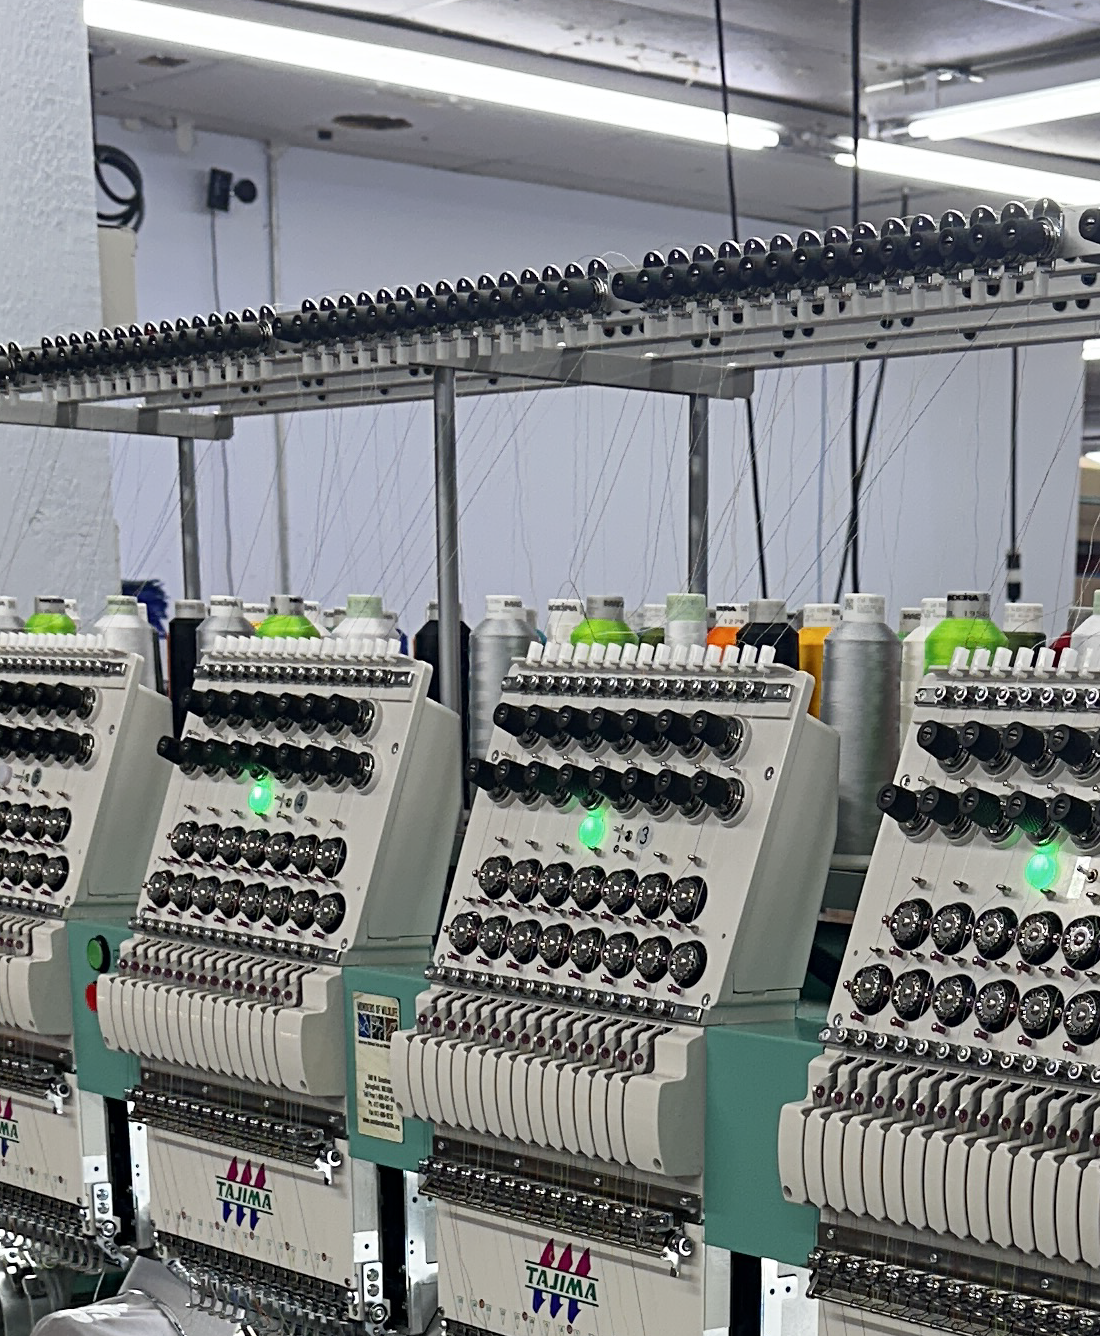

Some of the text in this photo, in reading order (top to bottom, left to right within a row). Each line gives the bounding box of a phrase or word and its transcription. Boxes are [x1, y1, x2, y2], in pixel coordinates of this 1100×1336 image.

[640, 826, 650, 845] 3
[216, 1180, 273, 1210] TAJIMA
[526, 1265, 598, 1302] TAJIMA
